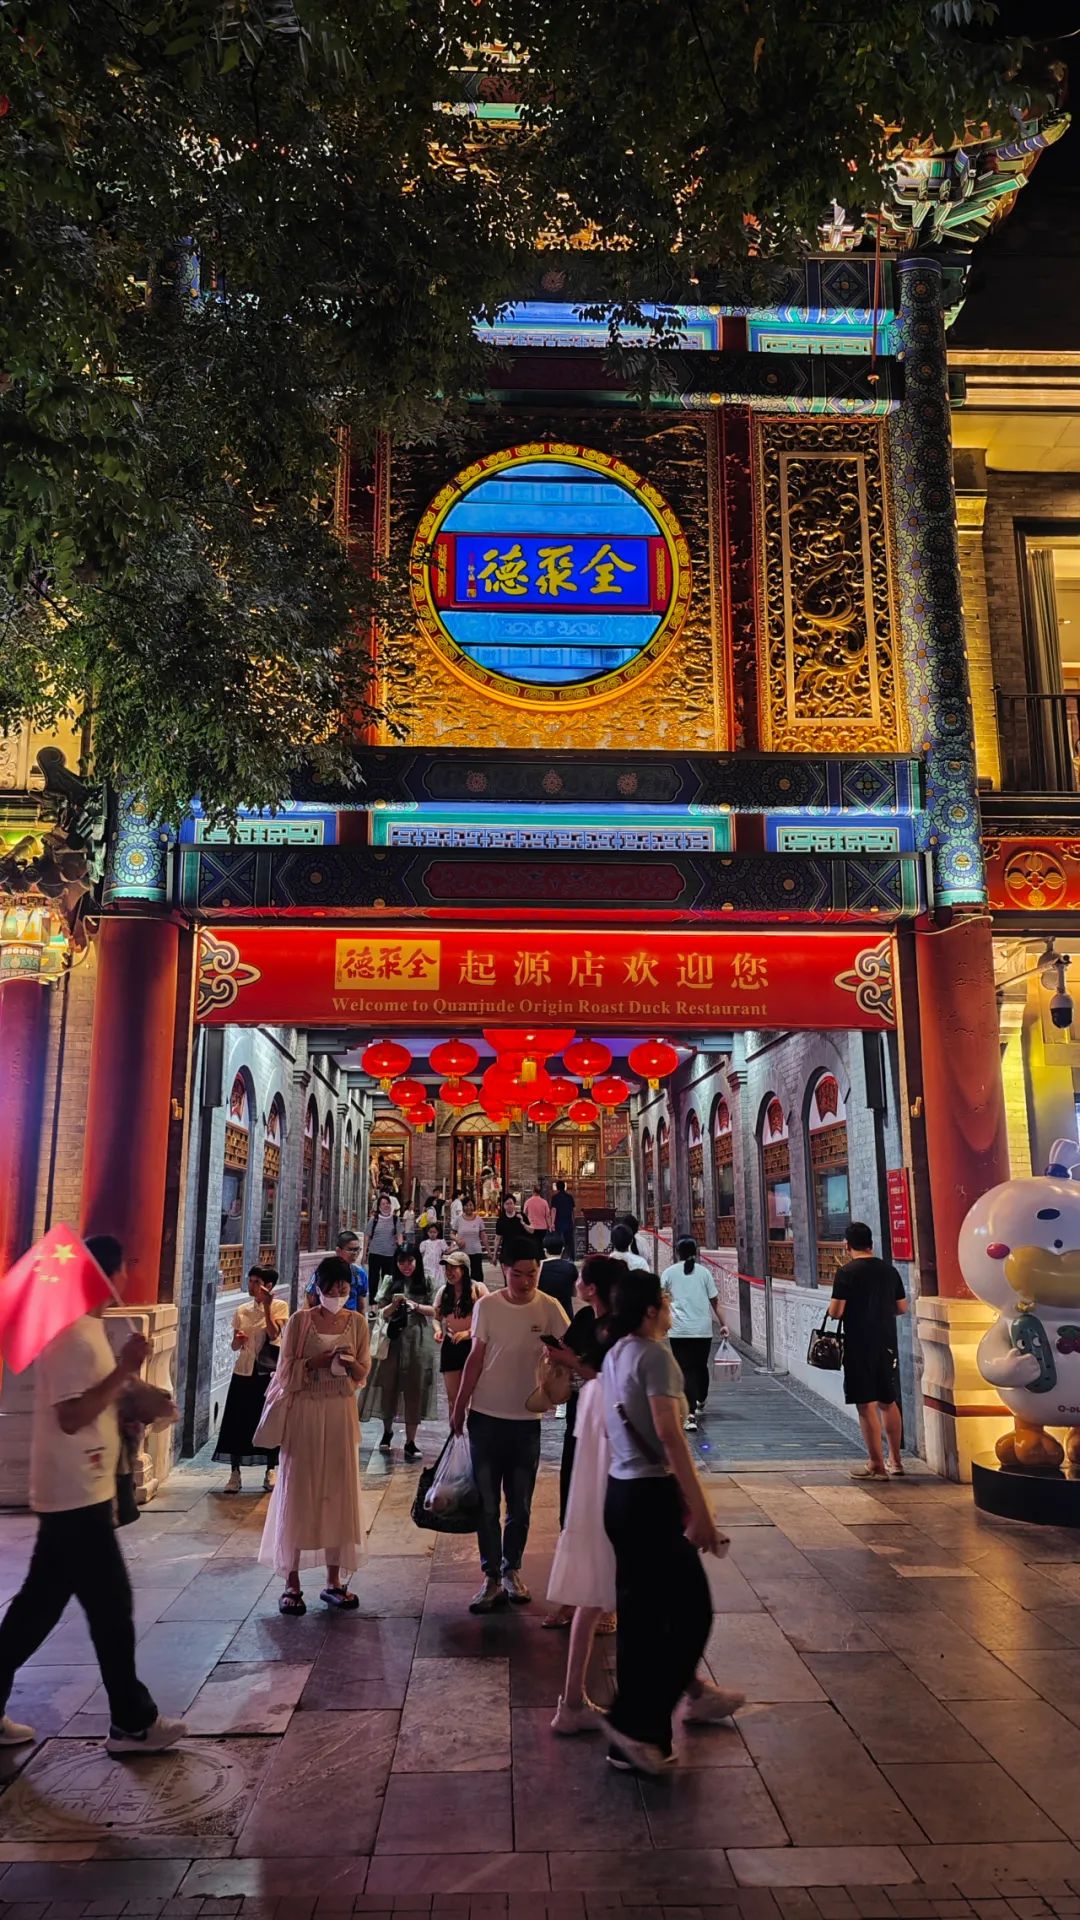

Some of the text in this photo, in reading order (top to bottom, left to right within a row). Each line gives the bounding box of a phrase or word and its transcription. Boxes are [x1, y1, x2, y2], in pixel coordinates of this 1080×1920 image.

[458, 949, 769, 990] 起源店欢迎您
[332, 997, 768, 1016] Welcome to Quanjude Origin Roast Duck Restaurant
